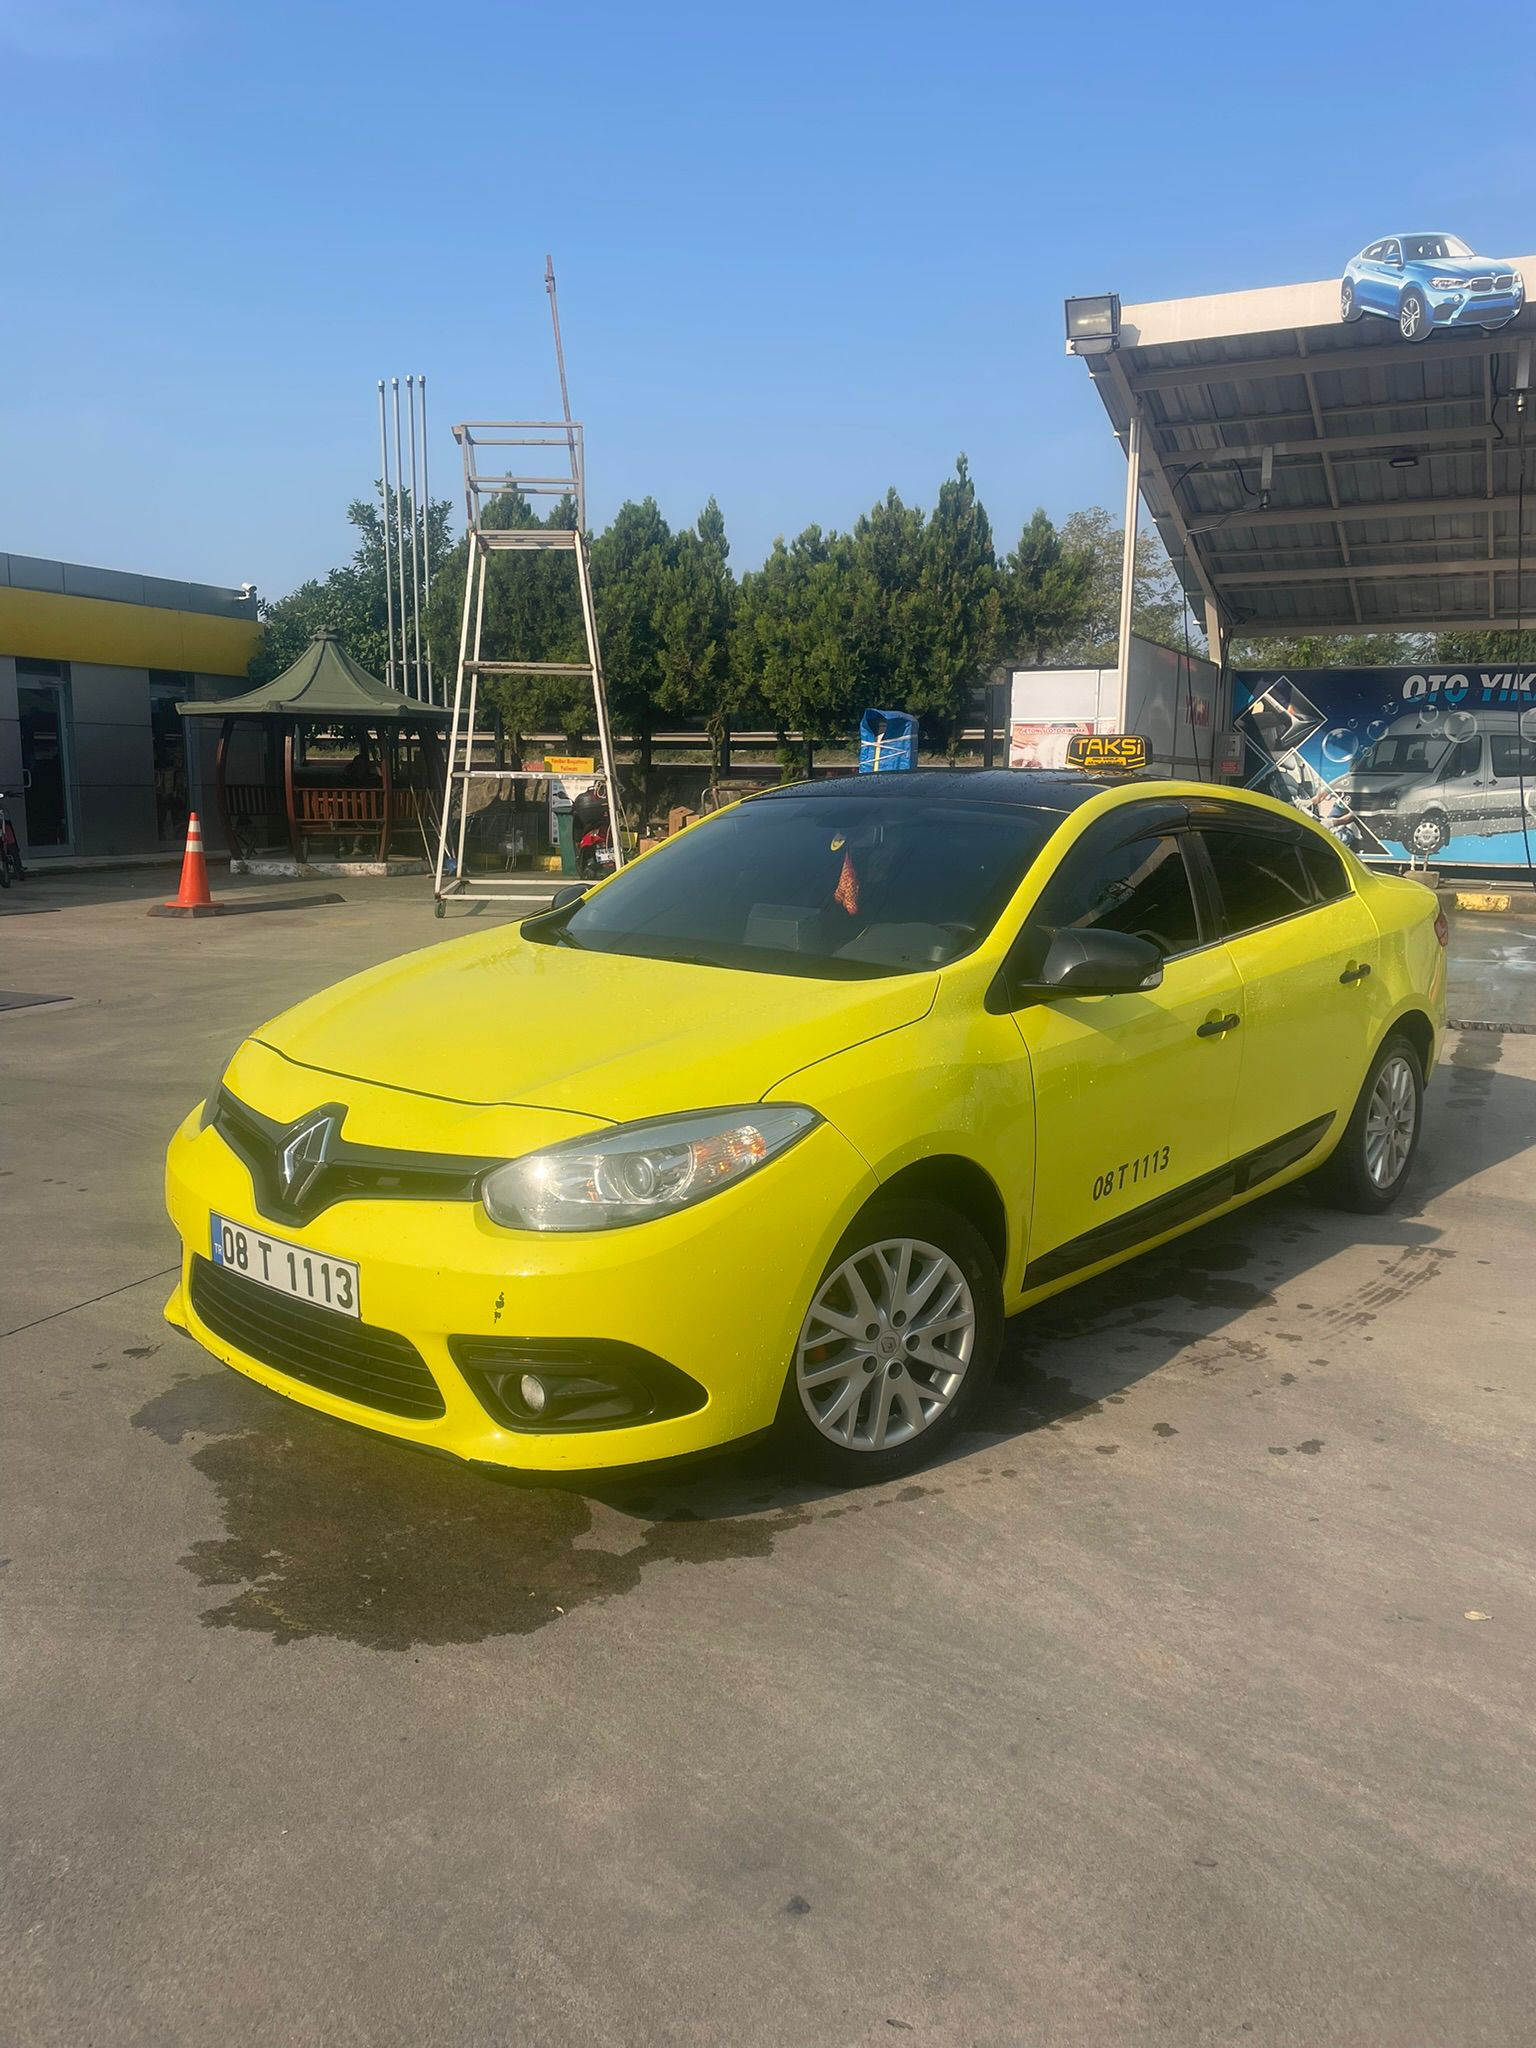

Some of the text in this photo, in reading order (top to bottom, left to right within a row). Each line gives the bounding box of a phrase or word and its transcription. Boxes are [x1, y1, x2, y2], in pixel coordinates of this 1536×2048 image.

[1402, 673, 1536, 703] OTO YIK
[1093, 1145, 1170, 1201] 08 T 1113
[222, 1226, 353, 1309] 08 T 1113
